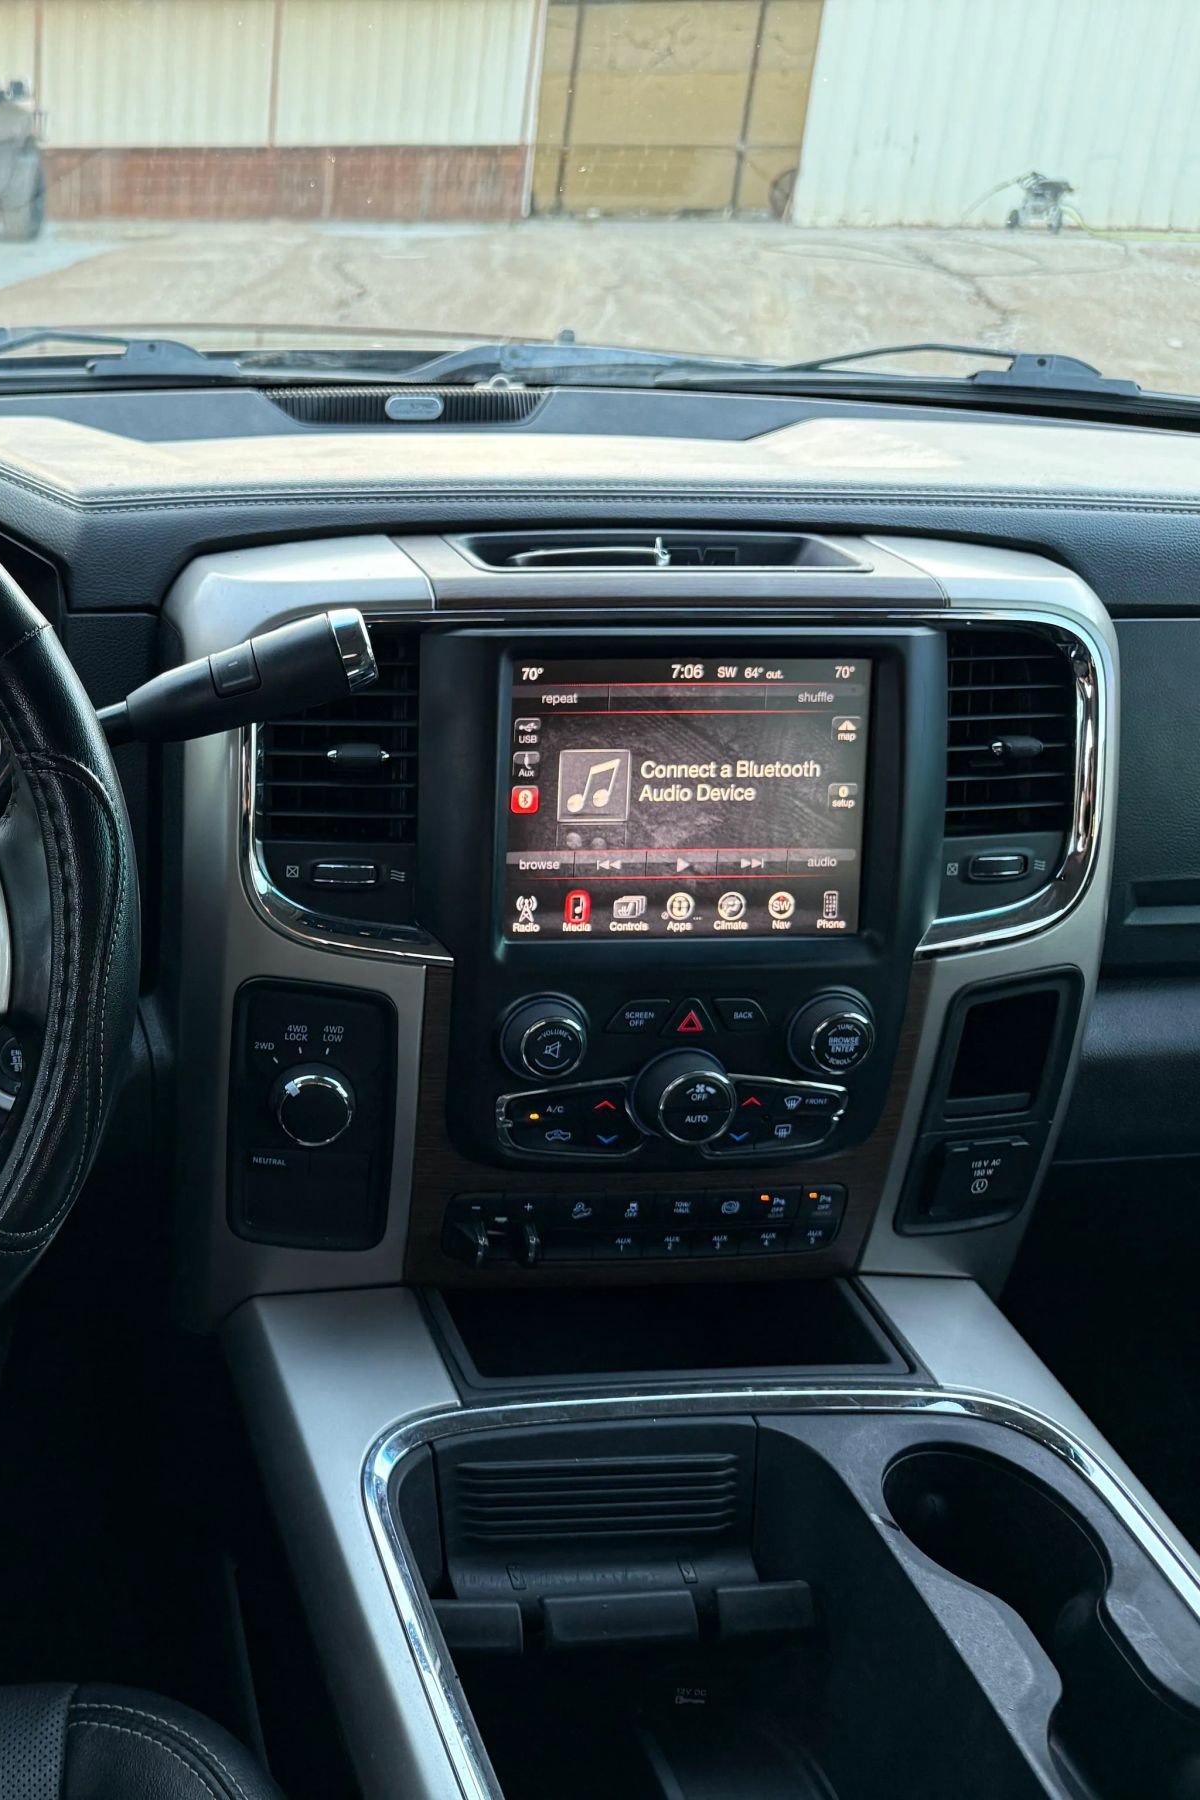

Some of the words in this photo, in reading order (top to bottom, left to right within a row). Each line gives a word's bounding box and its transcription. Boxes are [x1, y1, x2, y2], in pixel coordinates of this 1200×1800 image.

[521, 667, 544, 680] 70°
[672, 664, 704, 679] 7:06
[717, 666, 737, 678] SW
[744, 667, 764, 679] 64°
[834, 666, 856, 679] 70°
[541, 693, 578, 706] repeat
[798, 691, 834, 703] shuffle
[518, 735, 537, 744] USB
[837, 734, 856, 742] map
[518, 769, 534, 777] Aux
[640, 760, 717, 779] Connect
[720, 766, 733, 778] a
[736, 760, 822, 778] Bluetooth
[638, 784, 692, 802] Audio
[696, 784, 757, 802] Device
[831, 799, 855, 808] setup
[519, 859, 560, 870] browse
[807, 856, 837, 867] audio
[772, 901, 790, 911] SW
[512, 922, 540, 933] Radio
[562, 922, 592, 932] Media
[609, 921, 648, 932] Controls
[666, 922, 693, 933] Apps
[713, 920, 749, 930] Climate
[771, 920, 791, 930] Nav
[816, 919, 846, 929] Phone
[733, 1011, 753, 1019] BACK
[629, 1019, 644, 1027] OFF
[287, 1025, 307, 1033] 4WD
[323, 1025, 344, 1034] 4WD
[541, 1029, 569, 1038] VOLUME
[284, 1033, 308, 1042] LOCK
[322, 1034, 343, 1042] LOW
[828, 1036, 859, 1045] BROWSE
[254, 1042, 275, 1051] 2WD
[831, 1045, 855, 1053] ENTER
[828, 1057, 851, 1065] SCROLL
[691, 1093, 707, 1101] OFF
[546, 1105, 564, 1113] A/C
[685, 1115, 709, 1123] AUTO
[252, 1156, 286, 1166] NEUTRAL
